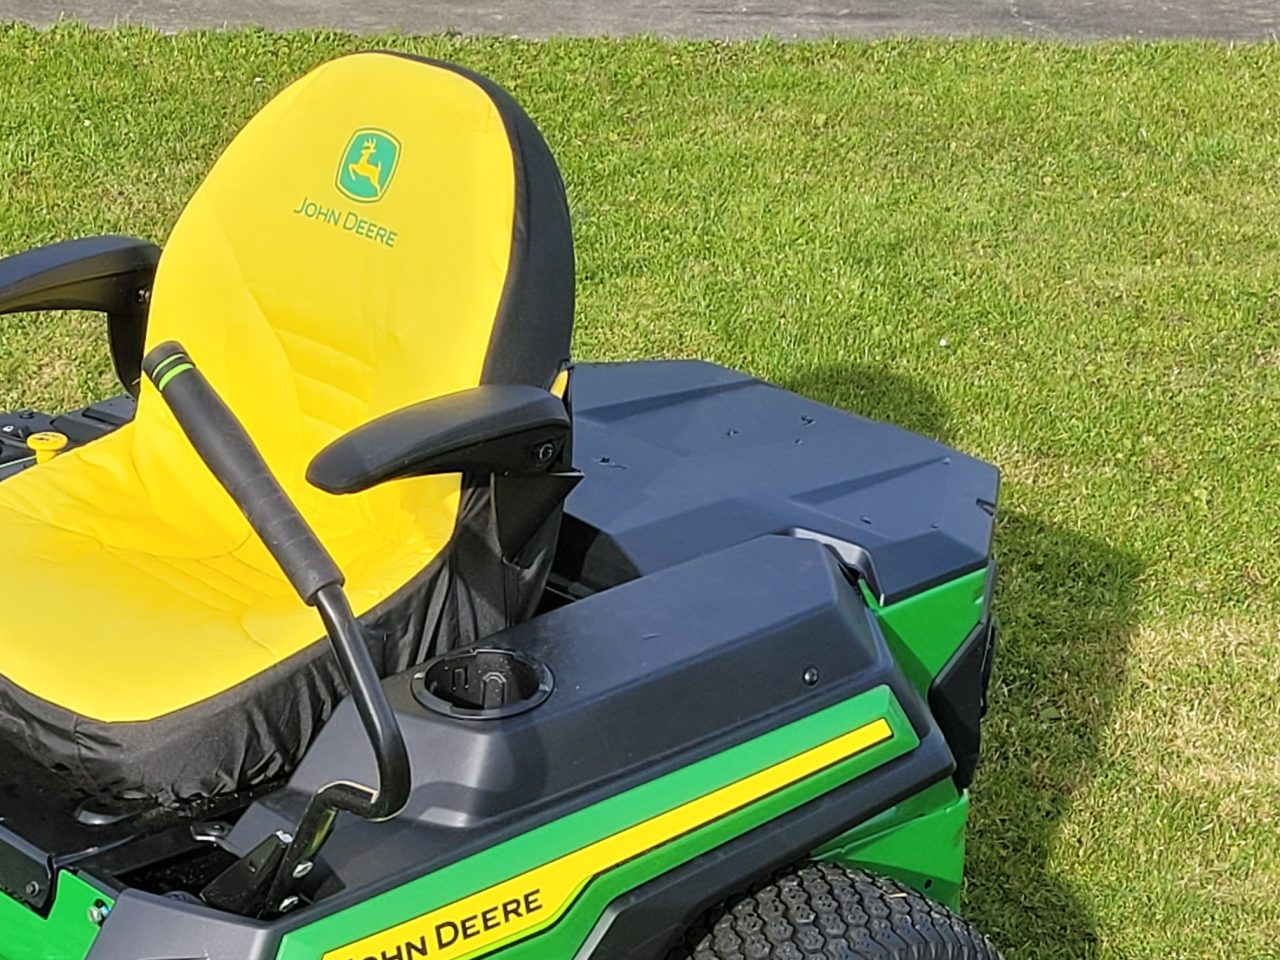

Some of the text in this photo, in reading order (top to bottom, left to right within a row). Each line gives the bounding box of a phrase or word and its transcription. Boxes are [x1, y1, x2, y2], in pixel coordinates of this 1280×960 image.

[294, 197, 398, 248] JOHN DEERE
[434, 888, 544, 950] DEERE
